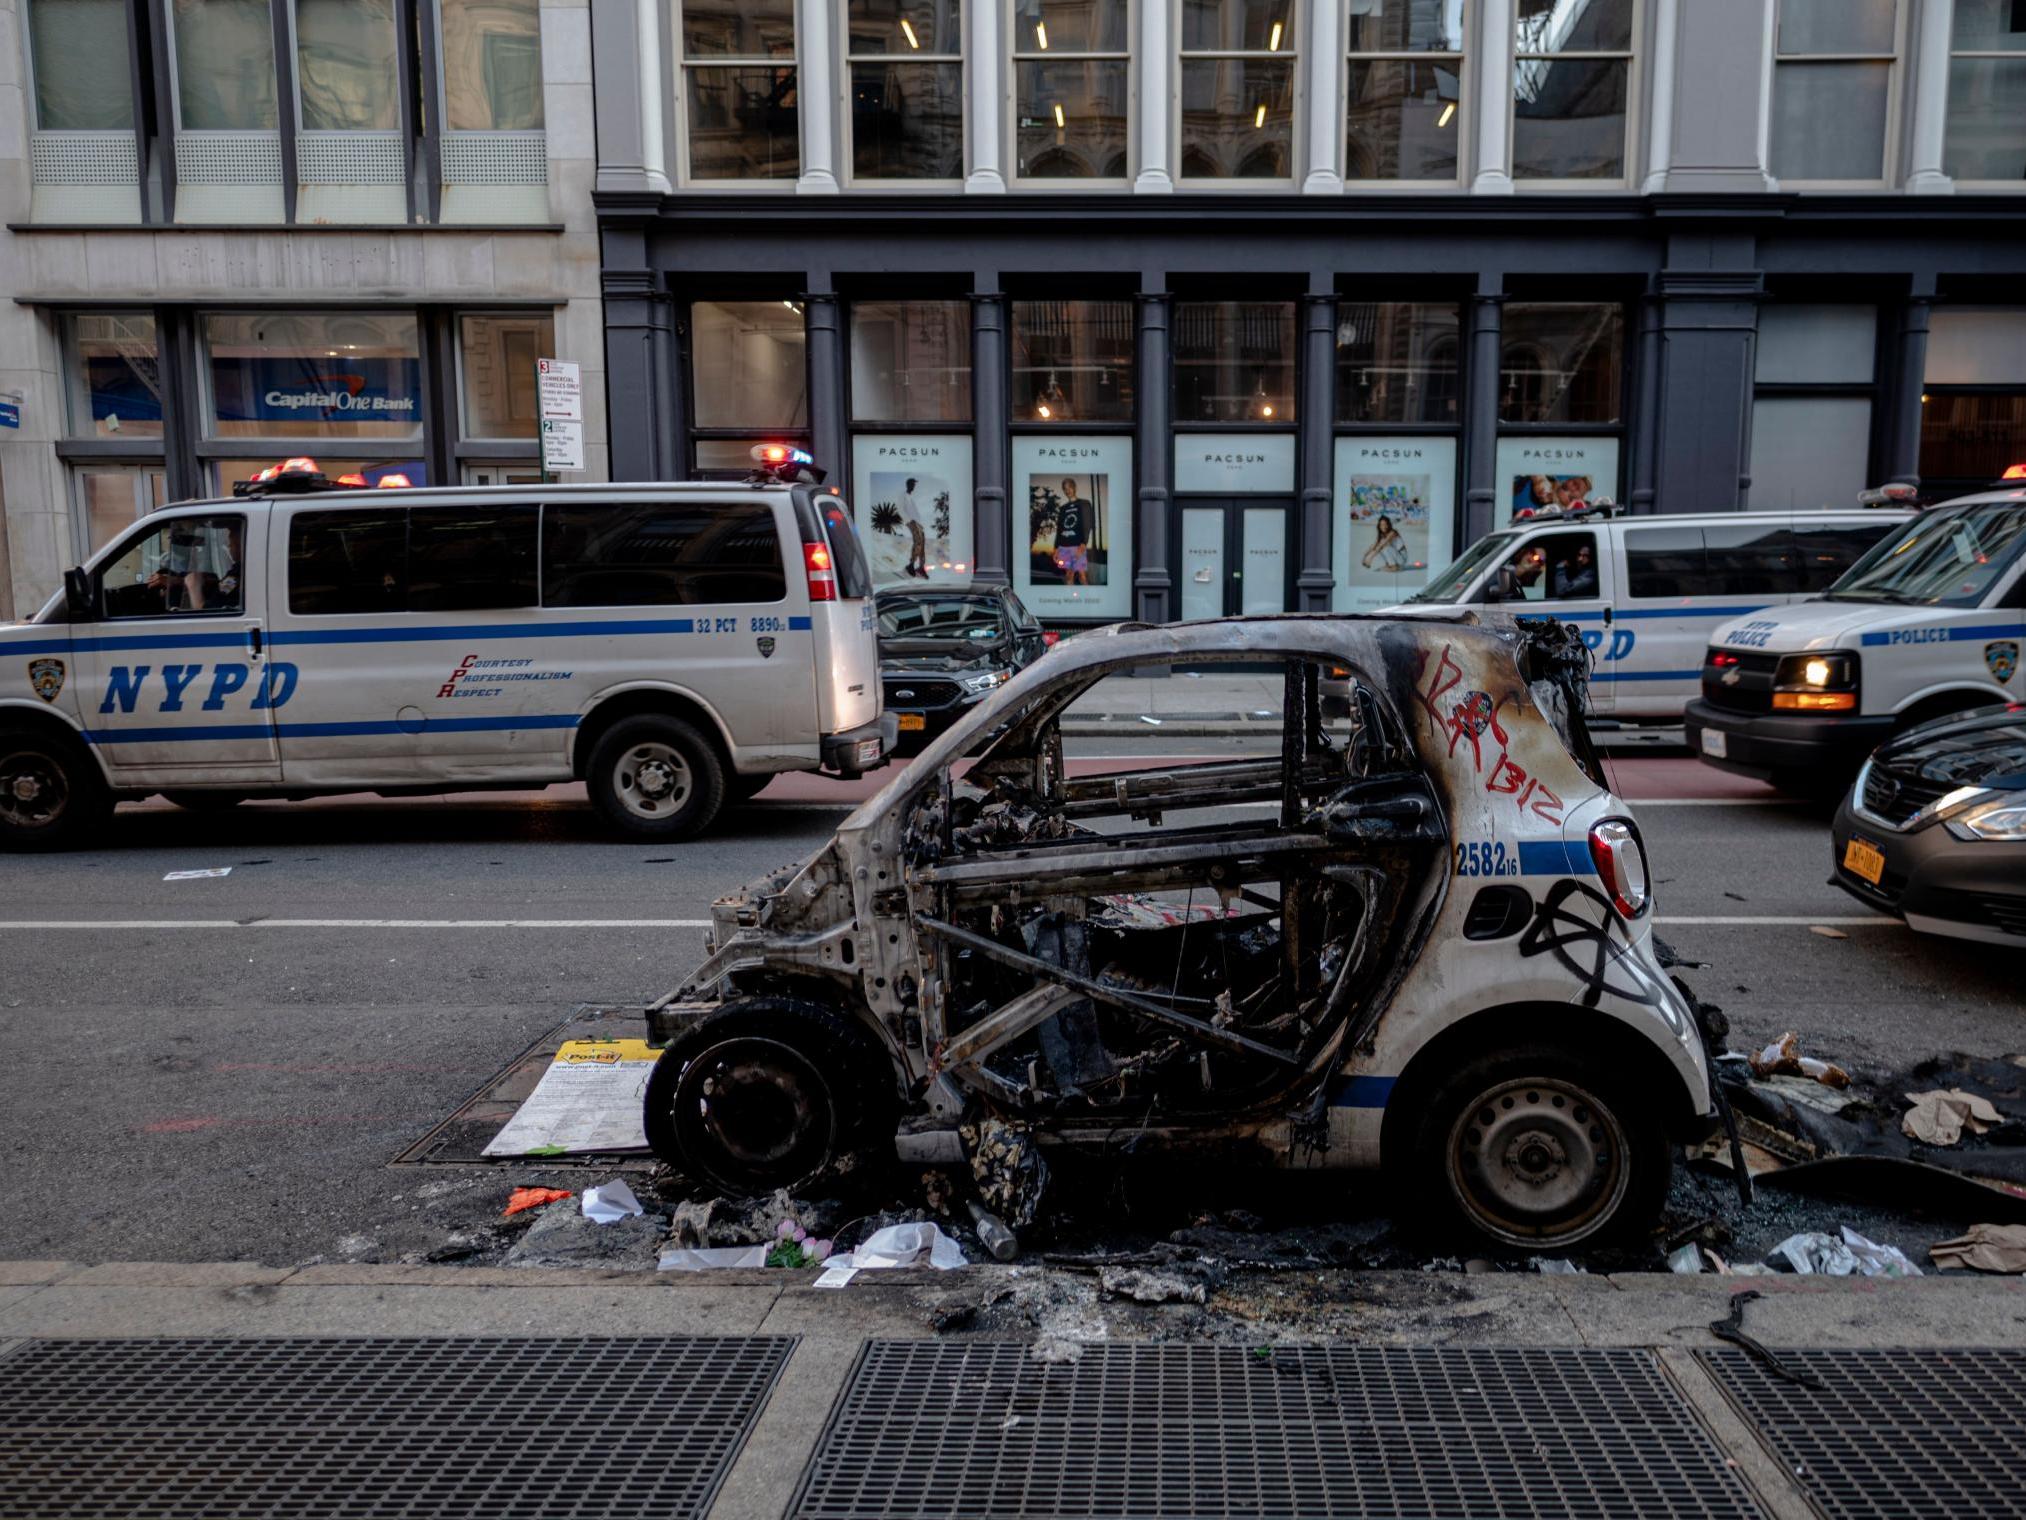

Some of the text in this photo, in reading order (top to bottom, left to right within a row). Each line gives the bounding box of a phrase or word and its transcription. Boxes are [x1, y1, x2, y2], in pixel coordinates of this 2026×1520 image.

[540, 361, 549, 374] 3
[372, 397, 413, 410] Bank
[544, 421, 552, 433] 2
[879, 447, 939, 456] PACSUN
[1038, 448, 1099, 457] PACSUN
[1361, 449, 1422, 457] PACSUN
[1523, 450, 1585, 458] PACSUN
[1204, 454, 1265, 463] PACSUN
[697, 618, 711, 633] 32
[715, 617, 738, 633] PCT
[1724, 630, 1773, 647] POLICE
[1892, 628, 1947, 644] POLICE
[98, 662, 299, 714] NYPD
[568, 1053, 616, 1061] Post-it
